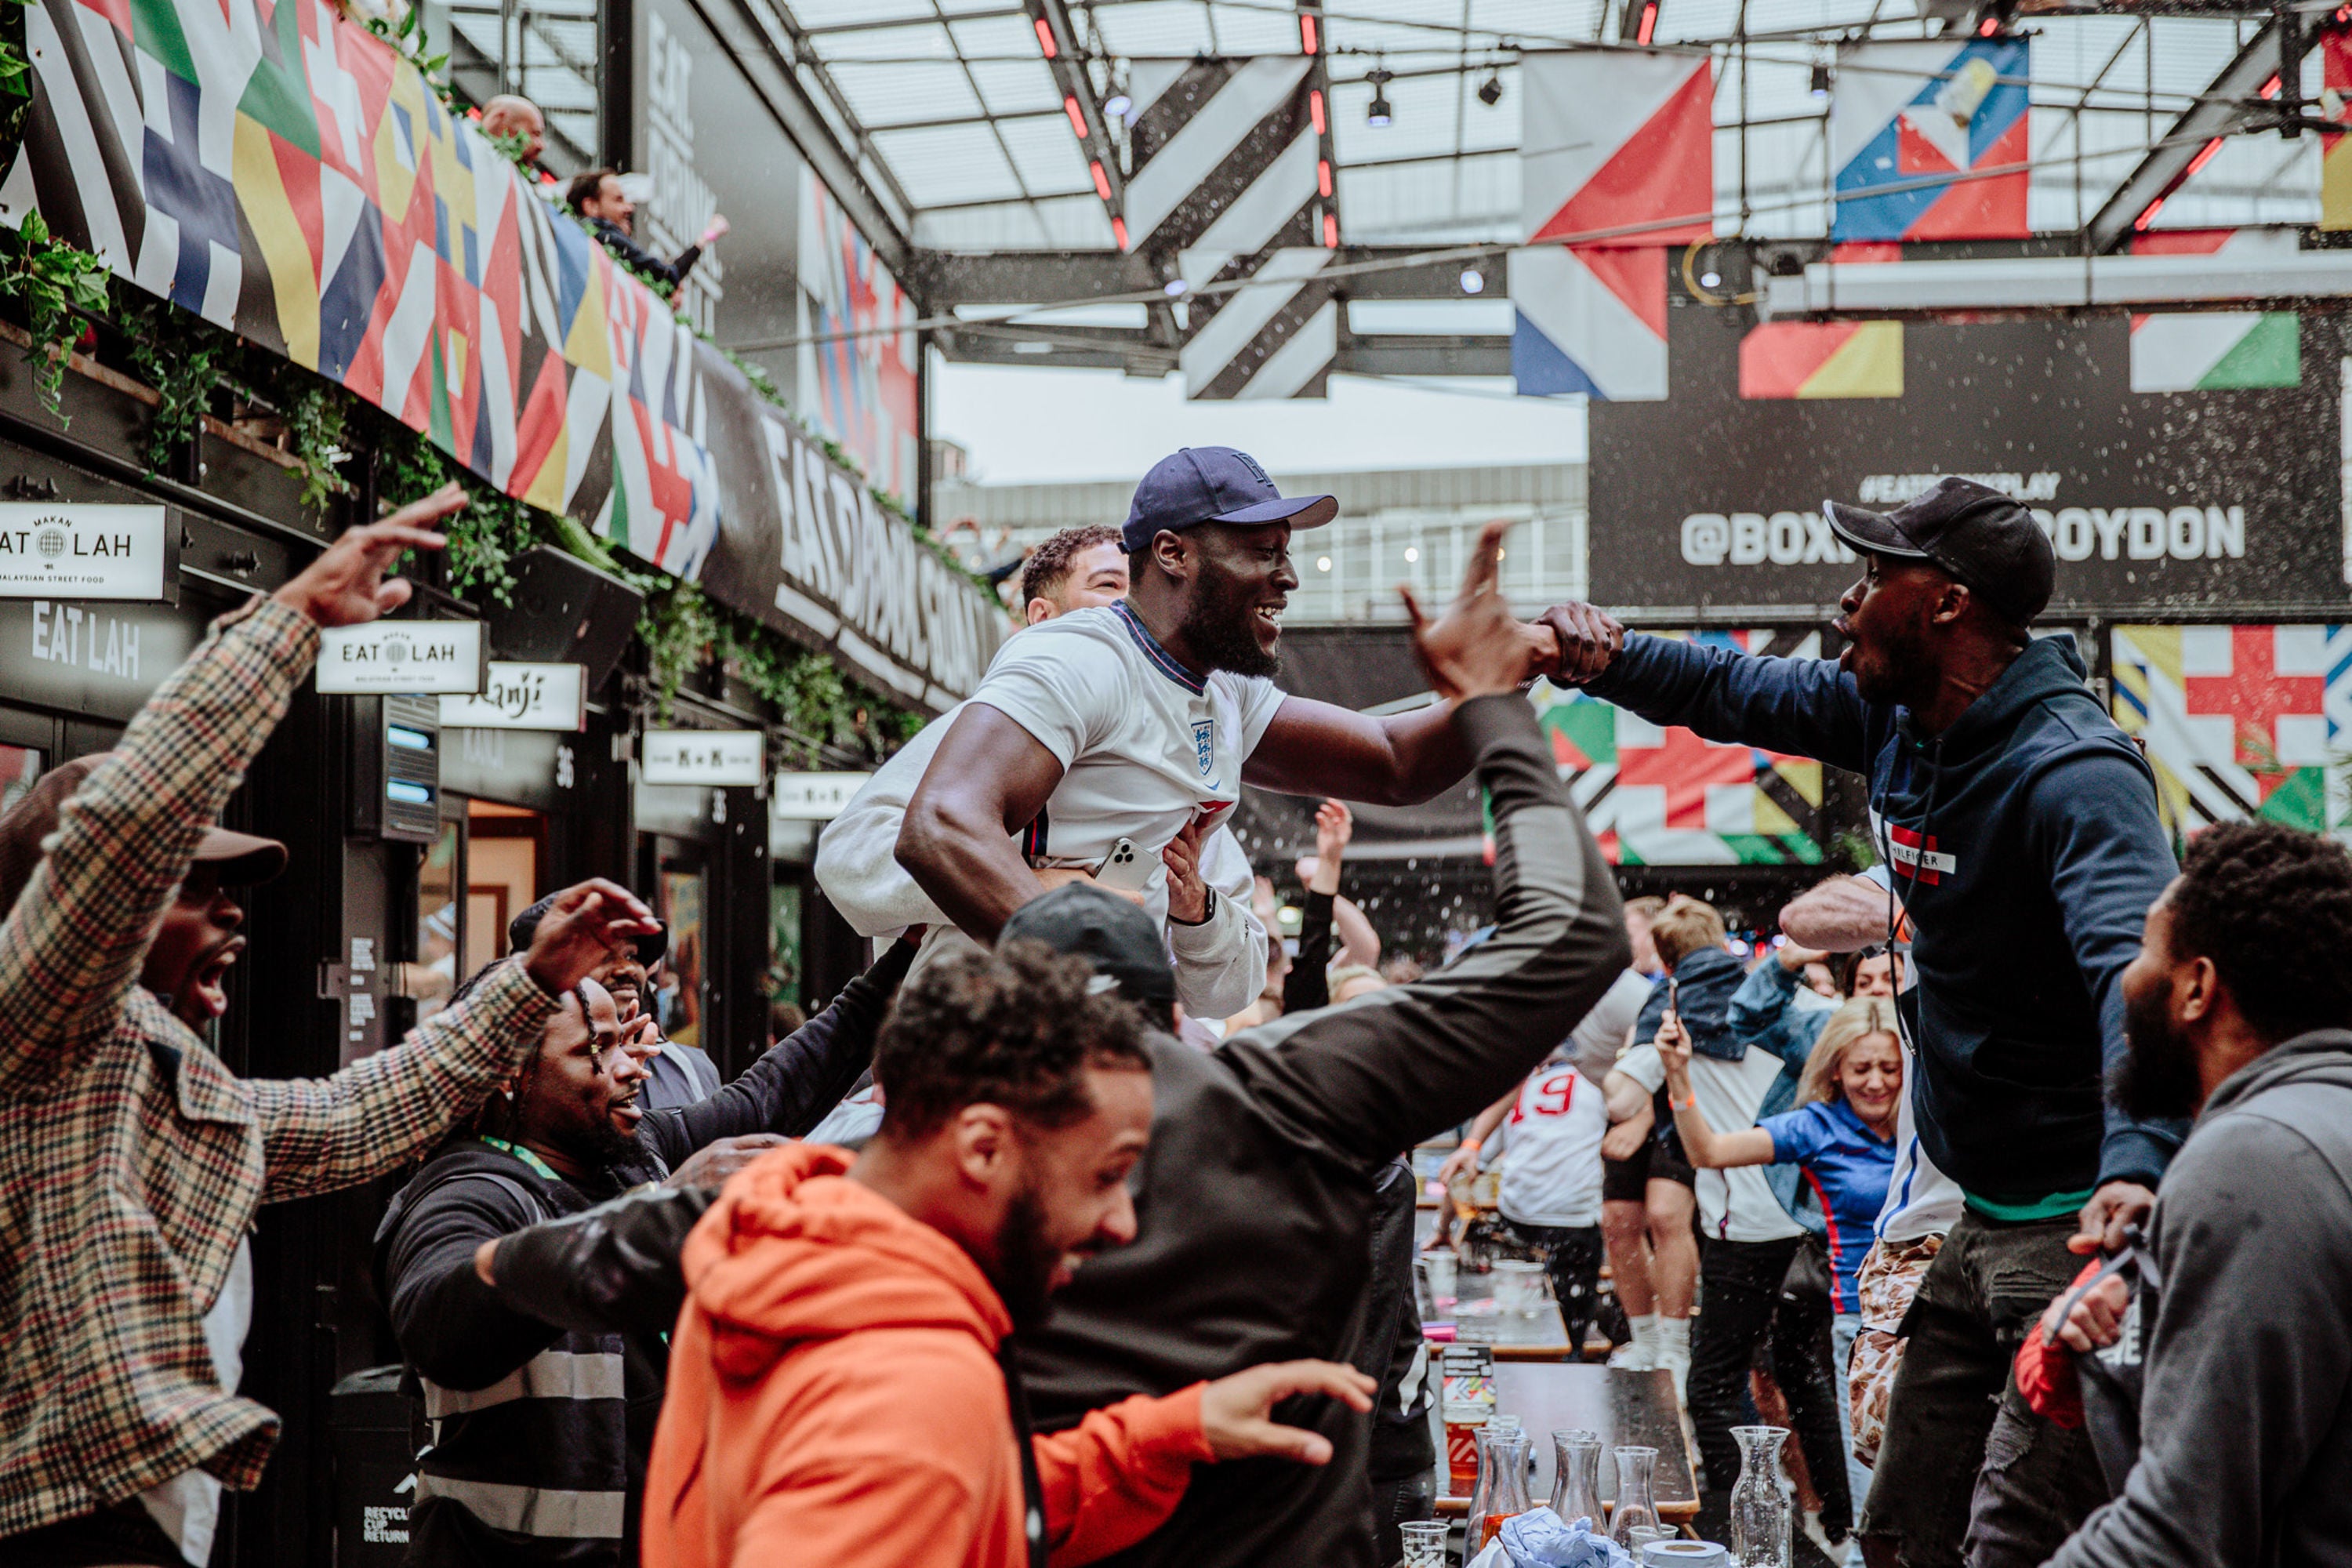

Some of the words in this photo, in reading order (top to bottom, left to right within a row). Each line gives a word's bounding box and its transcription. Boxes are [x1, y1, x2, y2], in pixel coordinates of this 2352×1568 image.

[34, 515, 72, 528] MAKAN
[0, 531, 31, 554] AT
[74, 533, 131, 557] LAH
[32, 601, 83, 666] EAT
[88, 612, 140, 681] LAH
[343, 644, 379, 662] EAT
[412, 644, 455, 662] LAH
[1510, 1073, 1575, 1125] 19
[363, 1506, 409, 1521] RECYCL
[363, 1518, 389, 1532] CUP
